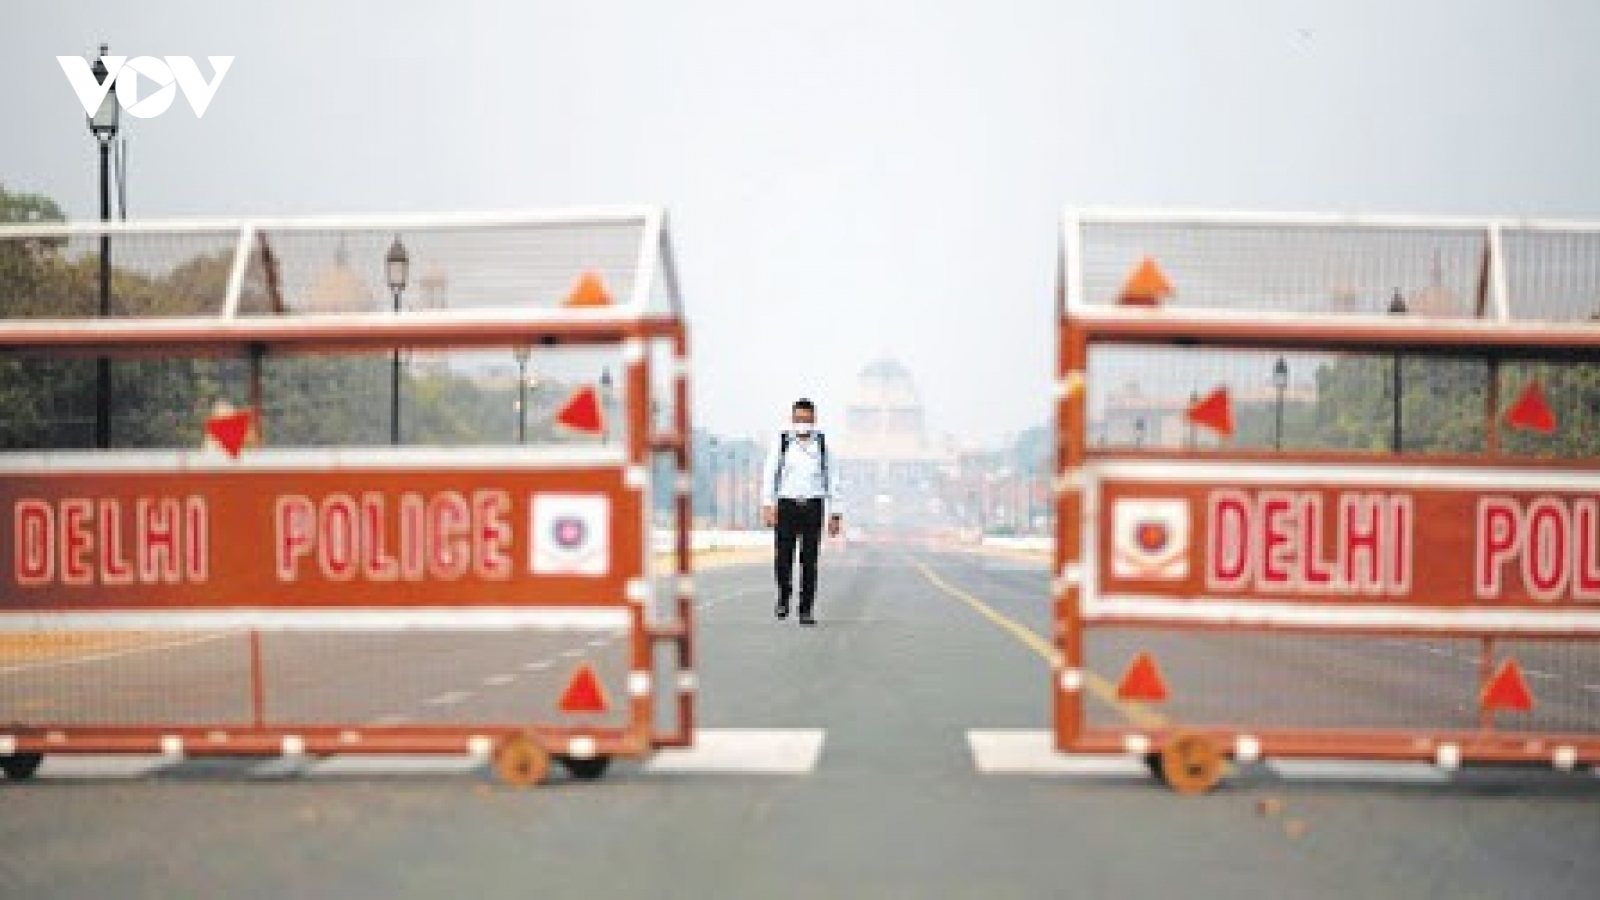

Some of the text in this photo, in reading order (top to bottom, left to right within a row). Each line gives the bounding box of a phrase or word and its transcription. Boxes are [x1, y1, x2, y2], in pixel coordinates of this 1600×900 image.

[14, 490, 512, 585] DELHI POLICE
[1206, 488, 1600, 601] DELHI POL
